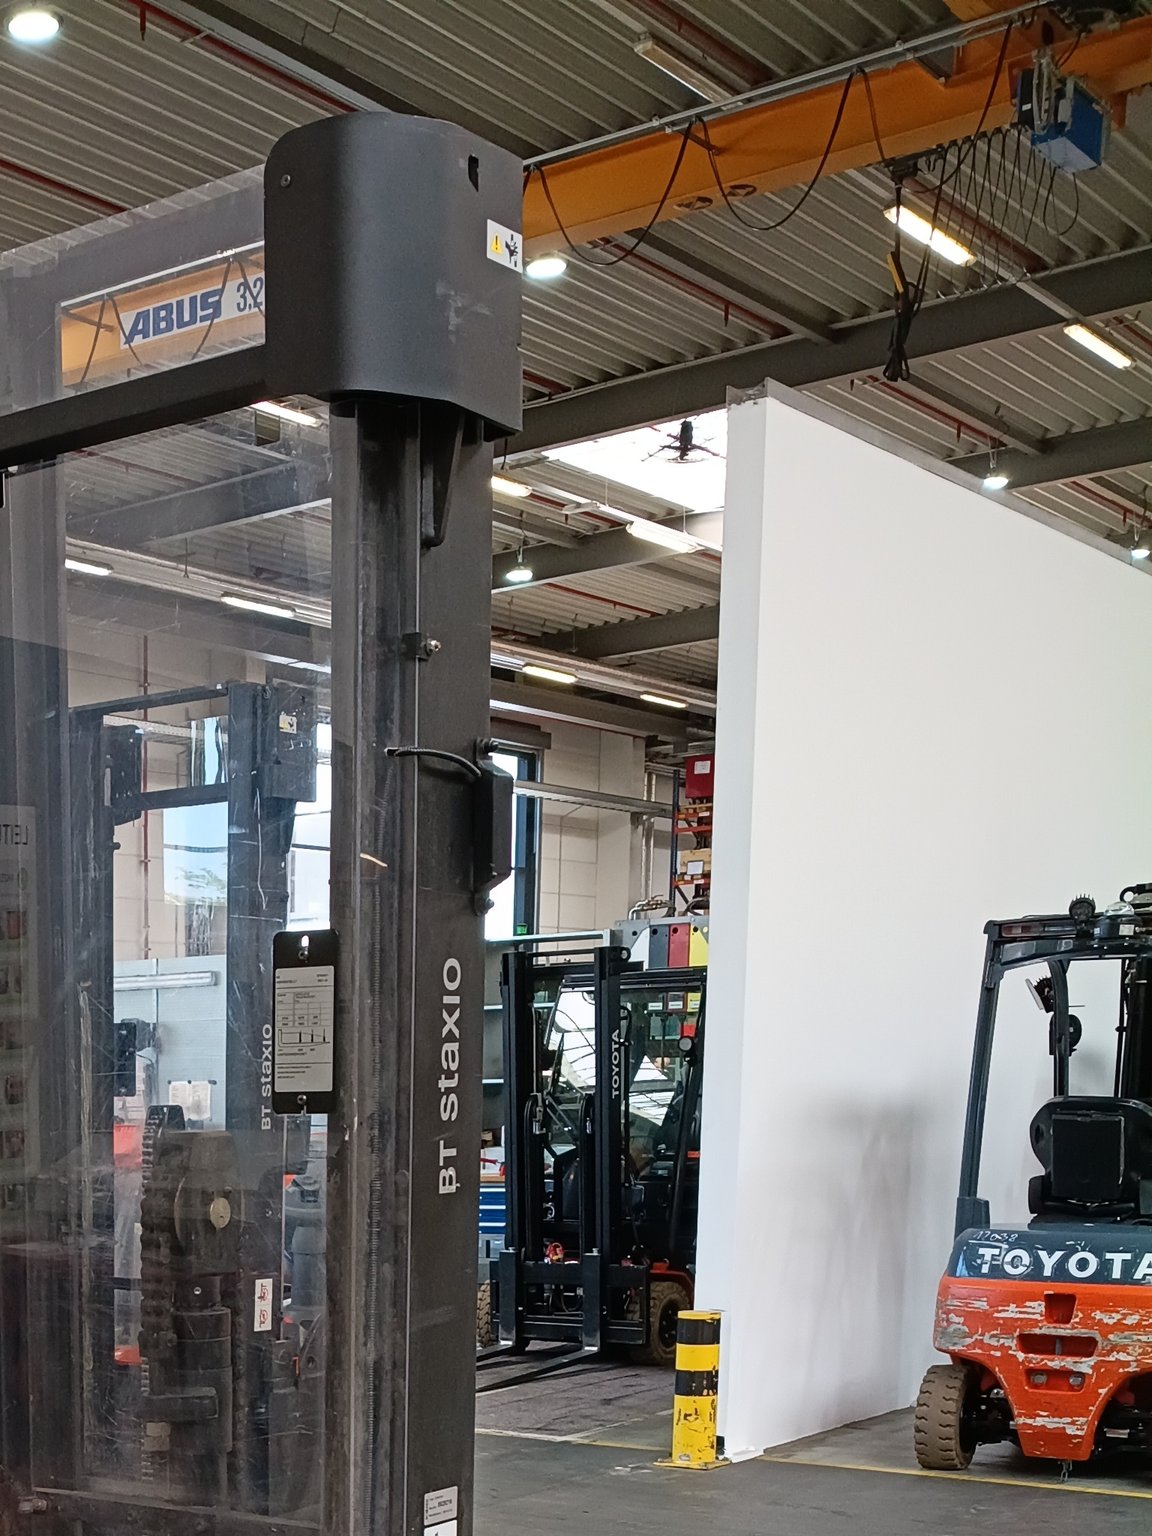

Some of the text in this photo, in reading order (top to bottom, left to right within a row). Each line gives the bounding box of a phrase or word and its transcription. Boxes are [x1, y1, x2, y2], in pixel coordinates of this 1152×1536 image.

[123, 288, 224, 345] ABUS
[611, 1029, 620, 1099] TOYOTA
[261, 1105, 272, 1130] BT
[439, 1140, 460, 1194] BT
[977, 1247, 1152, 1281] TOYOTA
